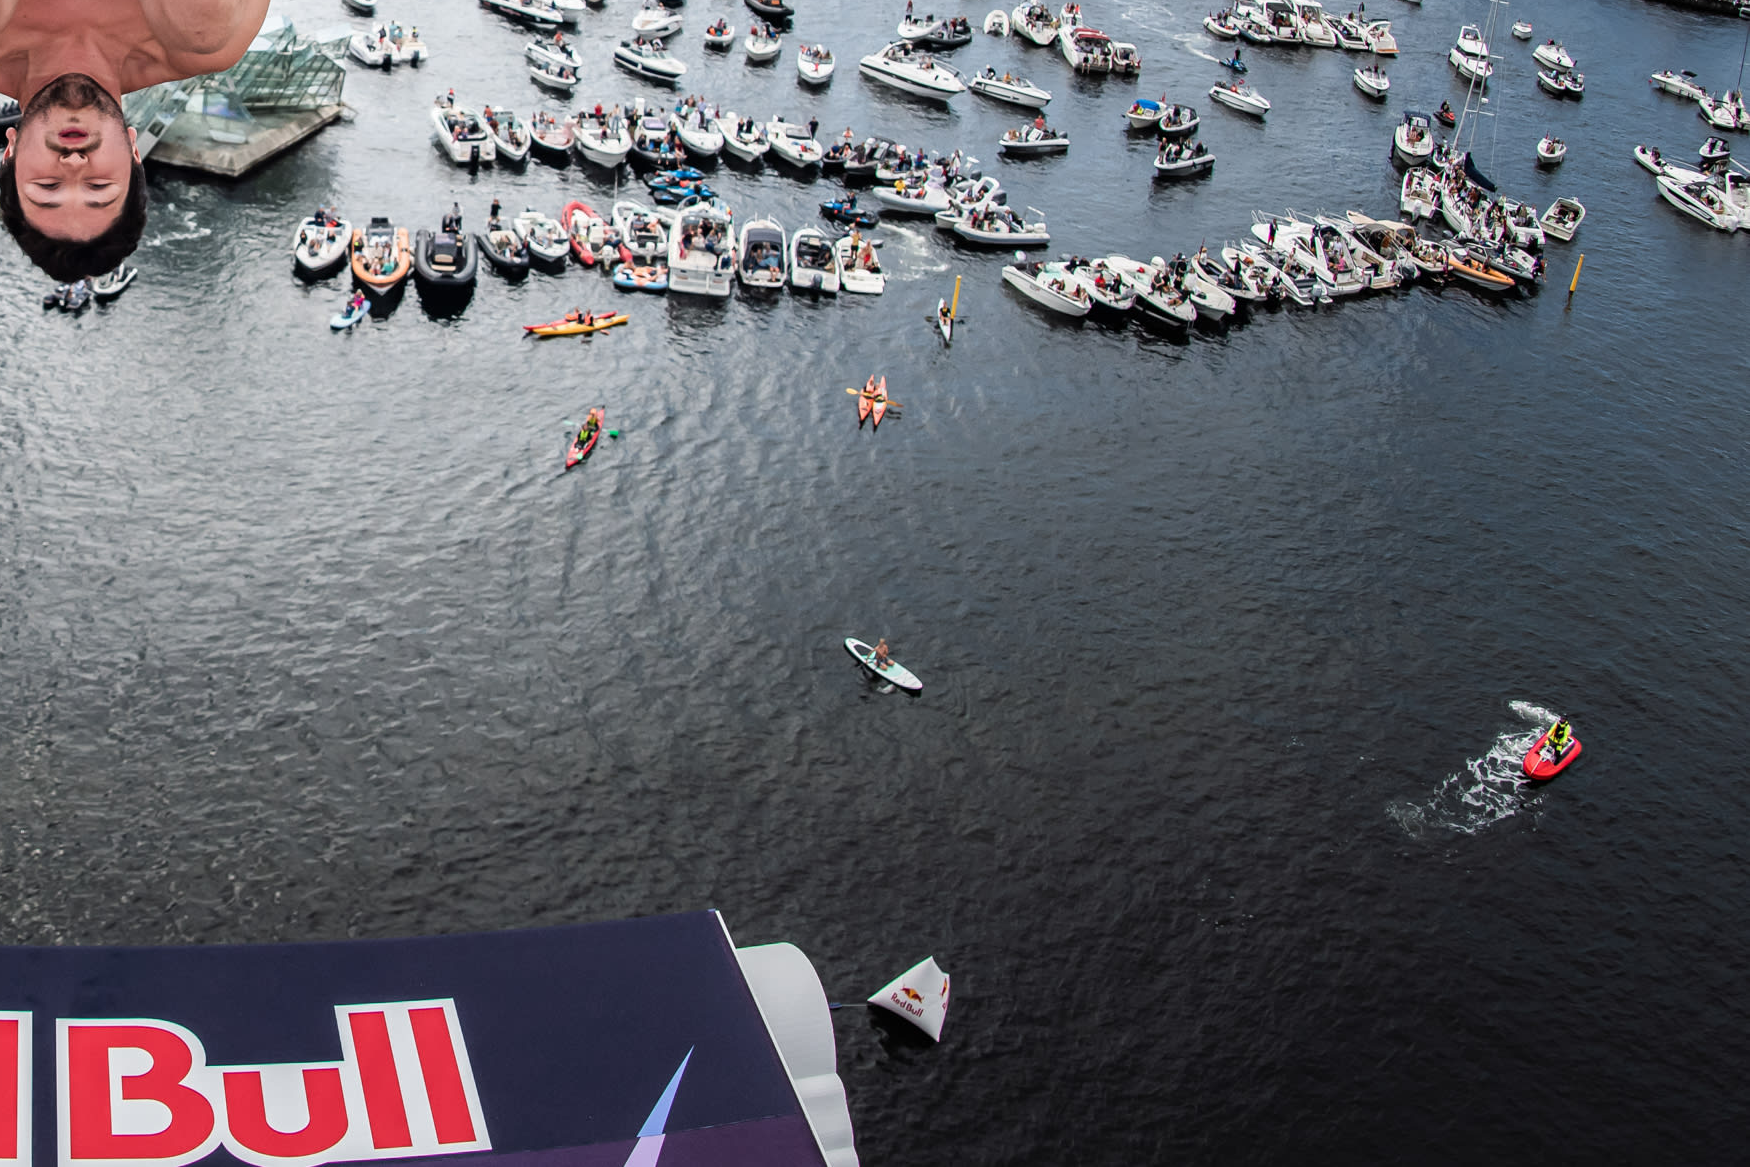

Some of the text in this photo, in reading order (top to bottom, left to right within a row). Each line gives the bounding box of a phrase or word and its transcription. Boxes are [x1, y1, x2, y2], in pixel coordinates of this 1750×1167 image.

[891, 992, 924, 1017] Red Bull
[58, 1005, 478, 1160] Bull
